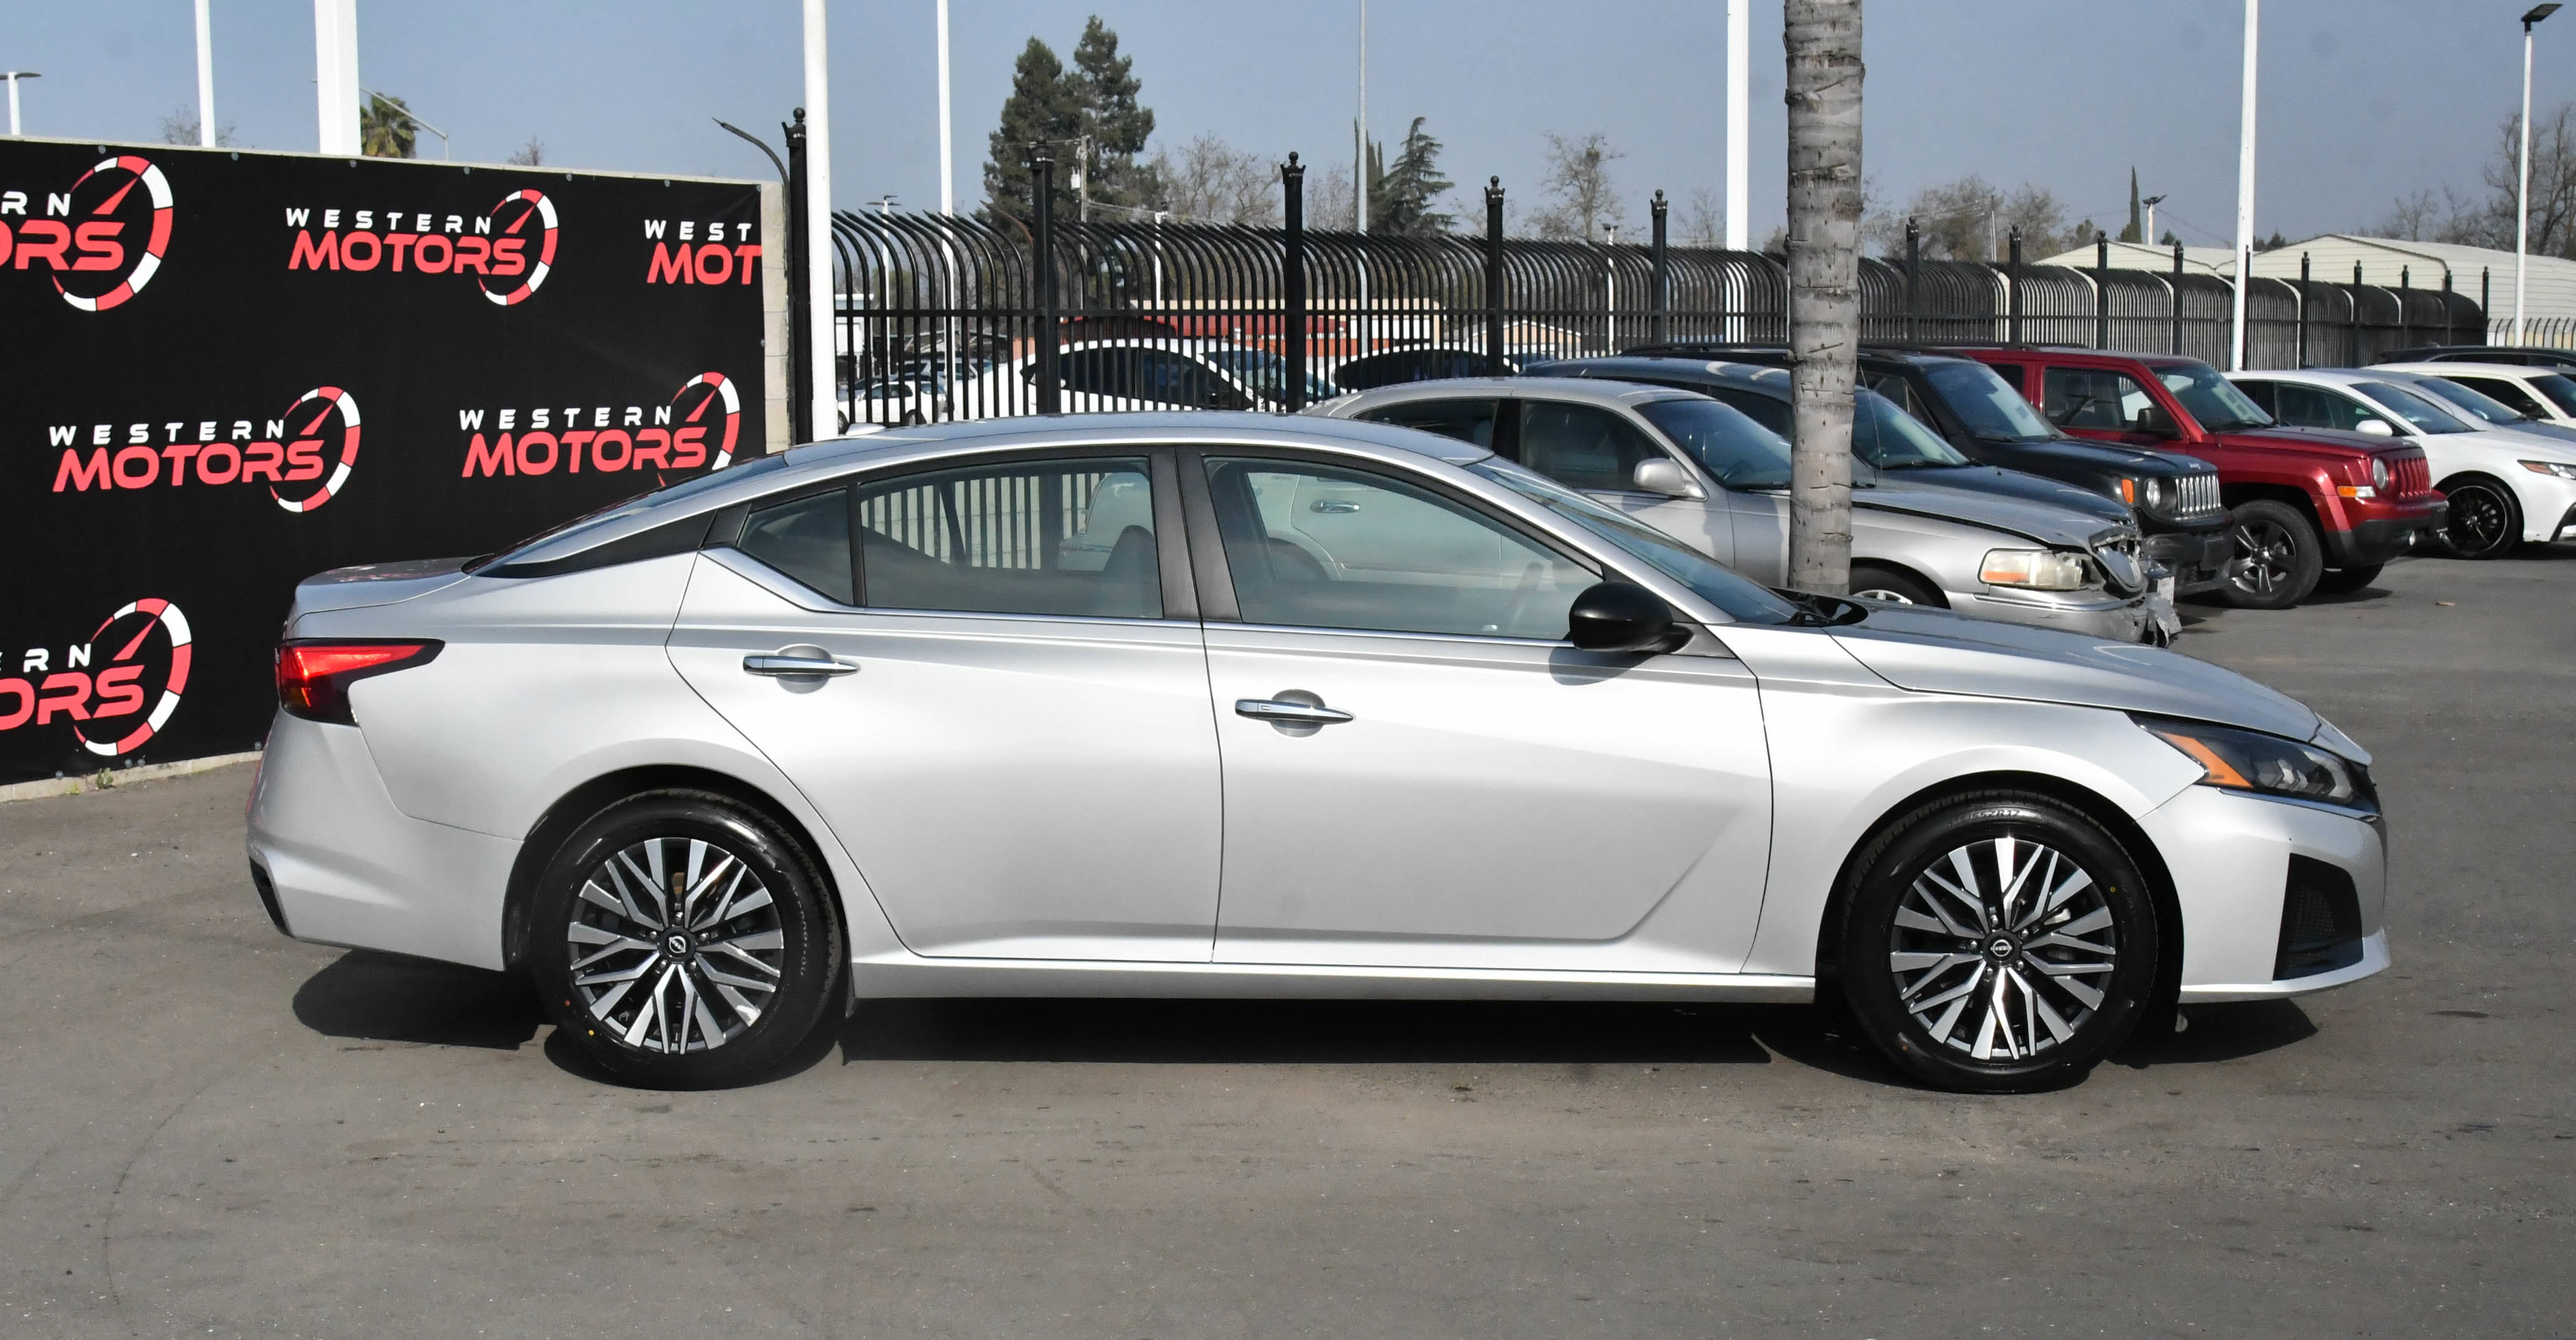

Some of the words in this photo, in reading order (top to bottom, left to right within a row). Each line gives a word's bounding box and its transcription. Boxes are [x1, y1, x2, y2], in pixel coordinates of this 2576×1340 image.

[285, 208, 491, 235] WESTERN
[644, 219, 752, 242] WEST
[0, 219, 126, 271] RS
[288, 229, 527, 277] MOTORS
[646, 241, 763, 285] MOT
[49, 419, 284, 447] WESTERN
[459, 405, 672, 431] WESTERN
[52, 439, 325, 492] MOTORS
[461, 426, 708, 478] MOTORS
[0, 643, 91, 673] RN
